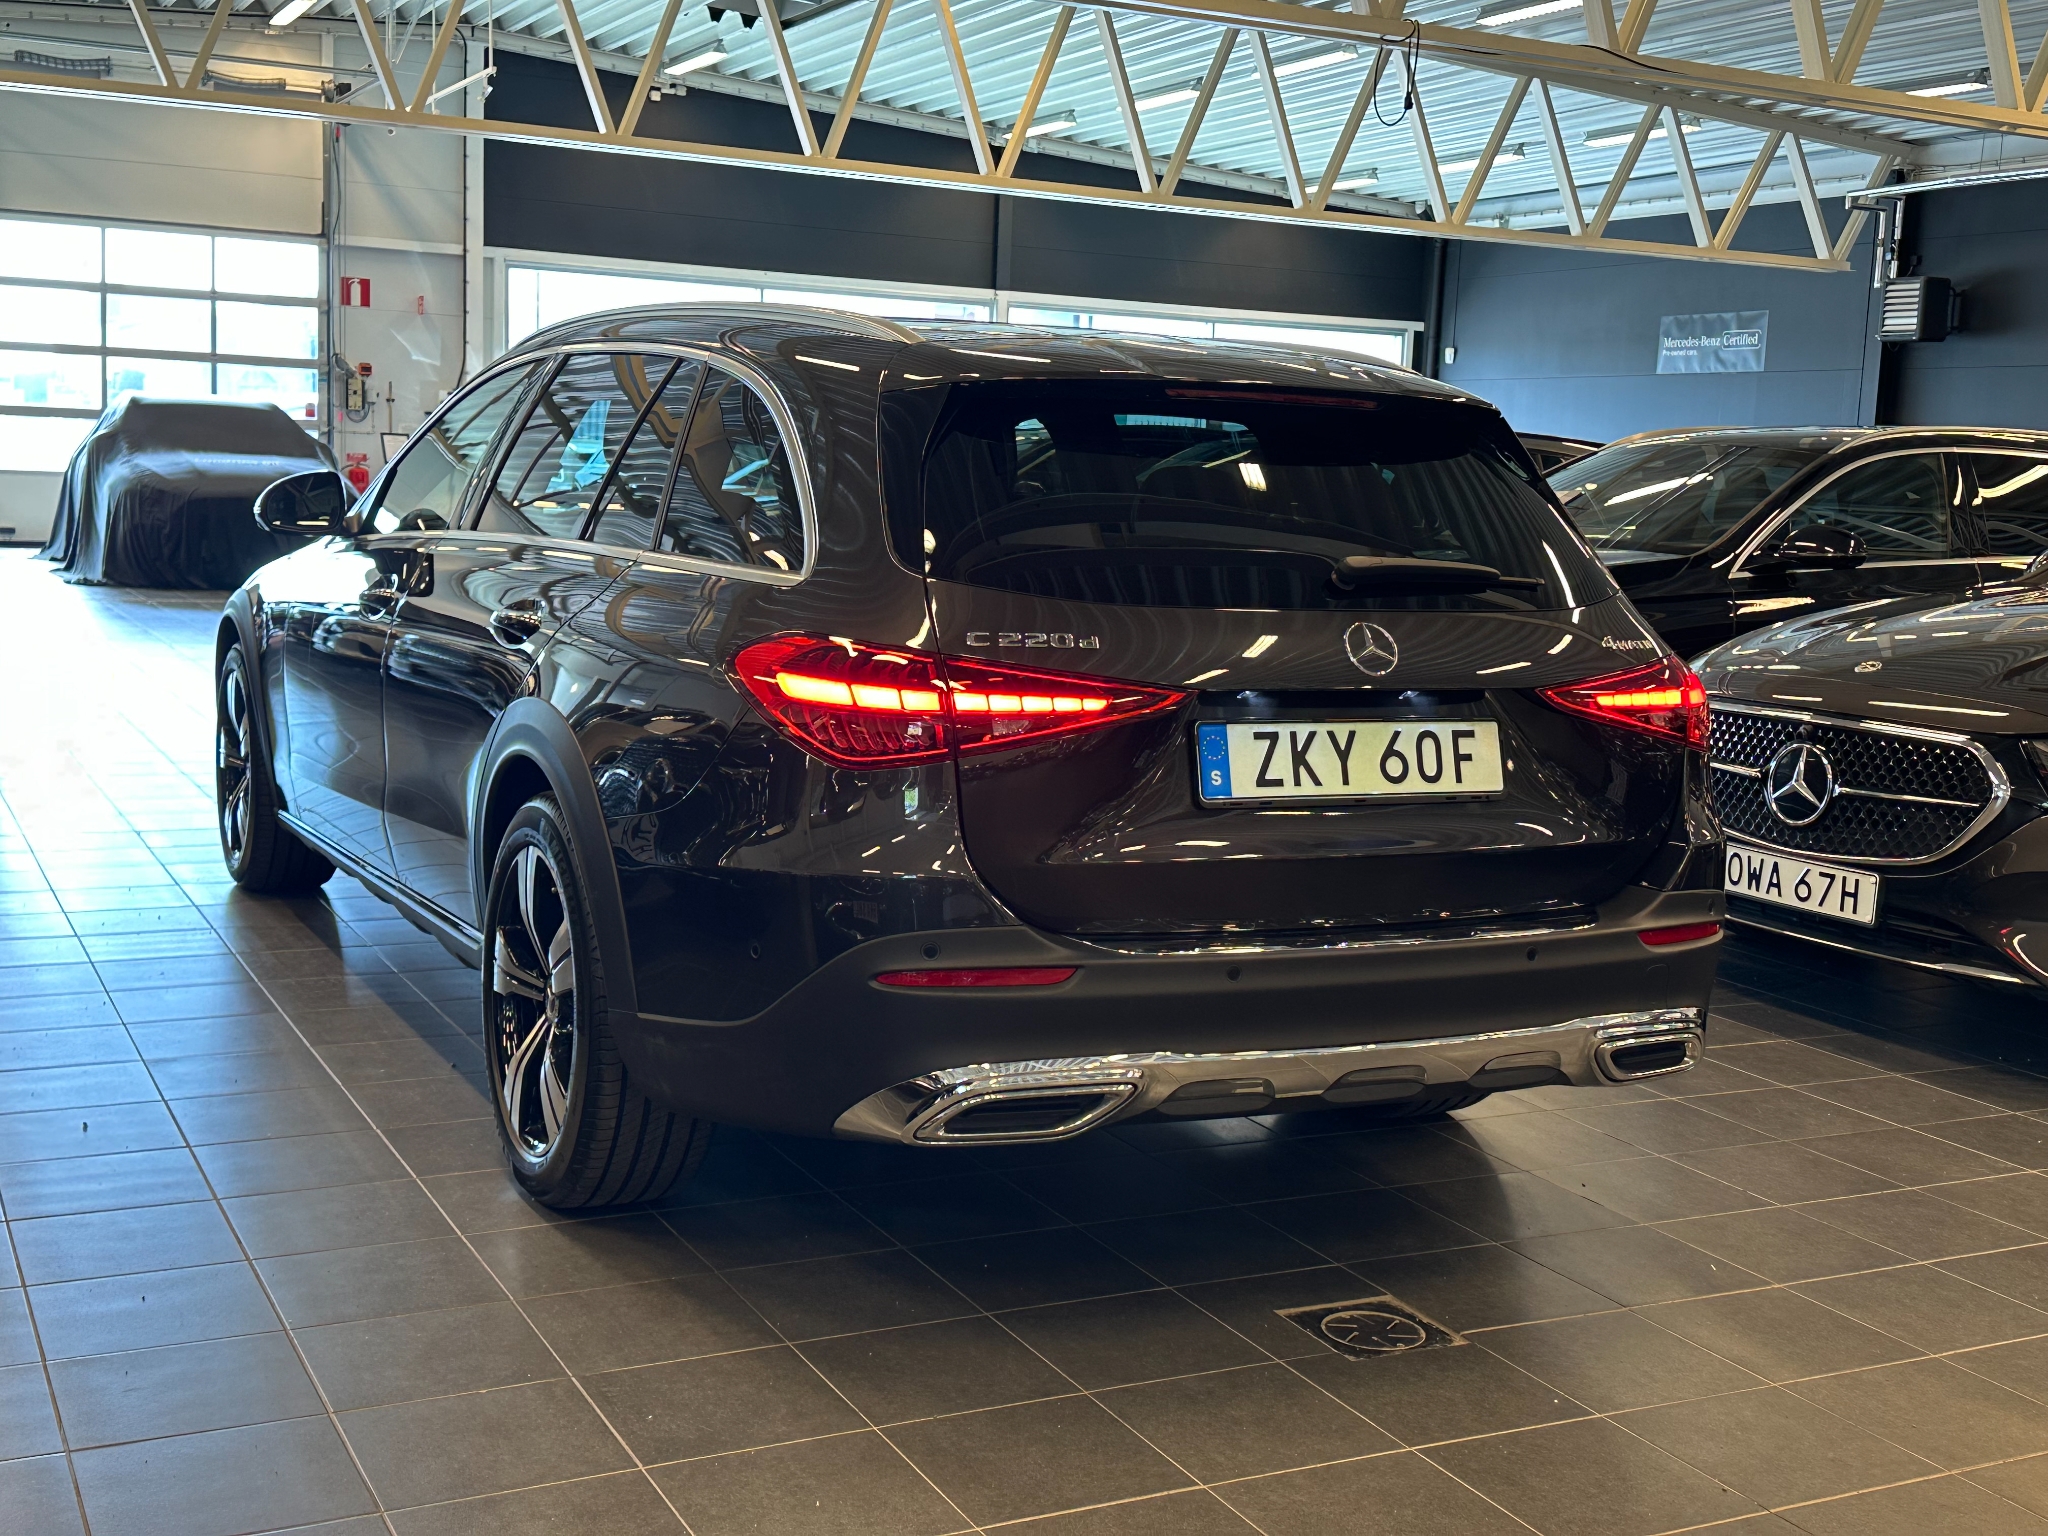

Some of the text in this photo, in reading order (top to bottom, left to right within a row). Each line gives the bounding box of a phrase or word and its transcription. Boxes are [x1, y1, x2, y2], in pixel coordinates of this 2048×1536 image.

[1663, 333, 1758, 348] Mercedes-Benz Certified
[966, 631, 990, 647] C
[1253, 729, 1475, 788] ZKY 60F
[1211, 770, 1222, 786] S
[1727, 852, 1860, 915] OWA 67H
